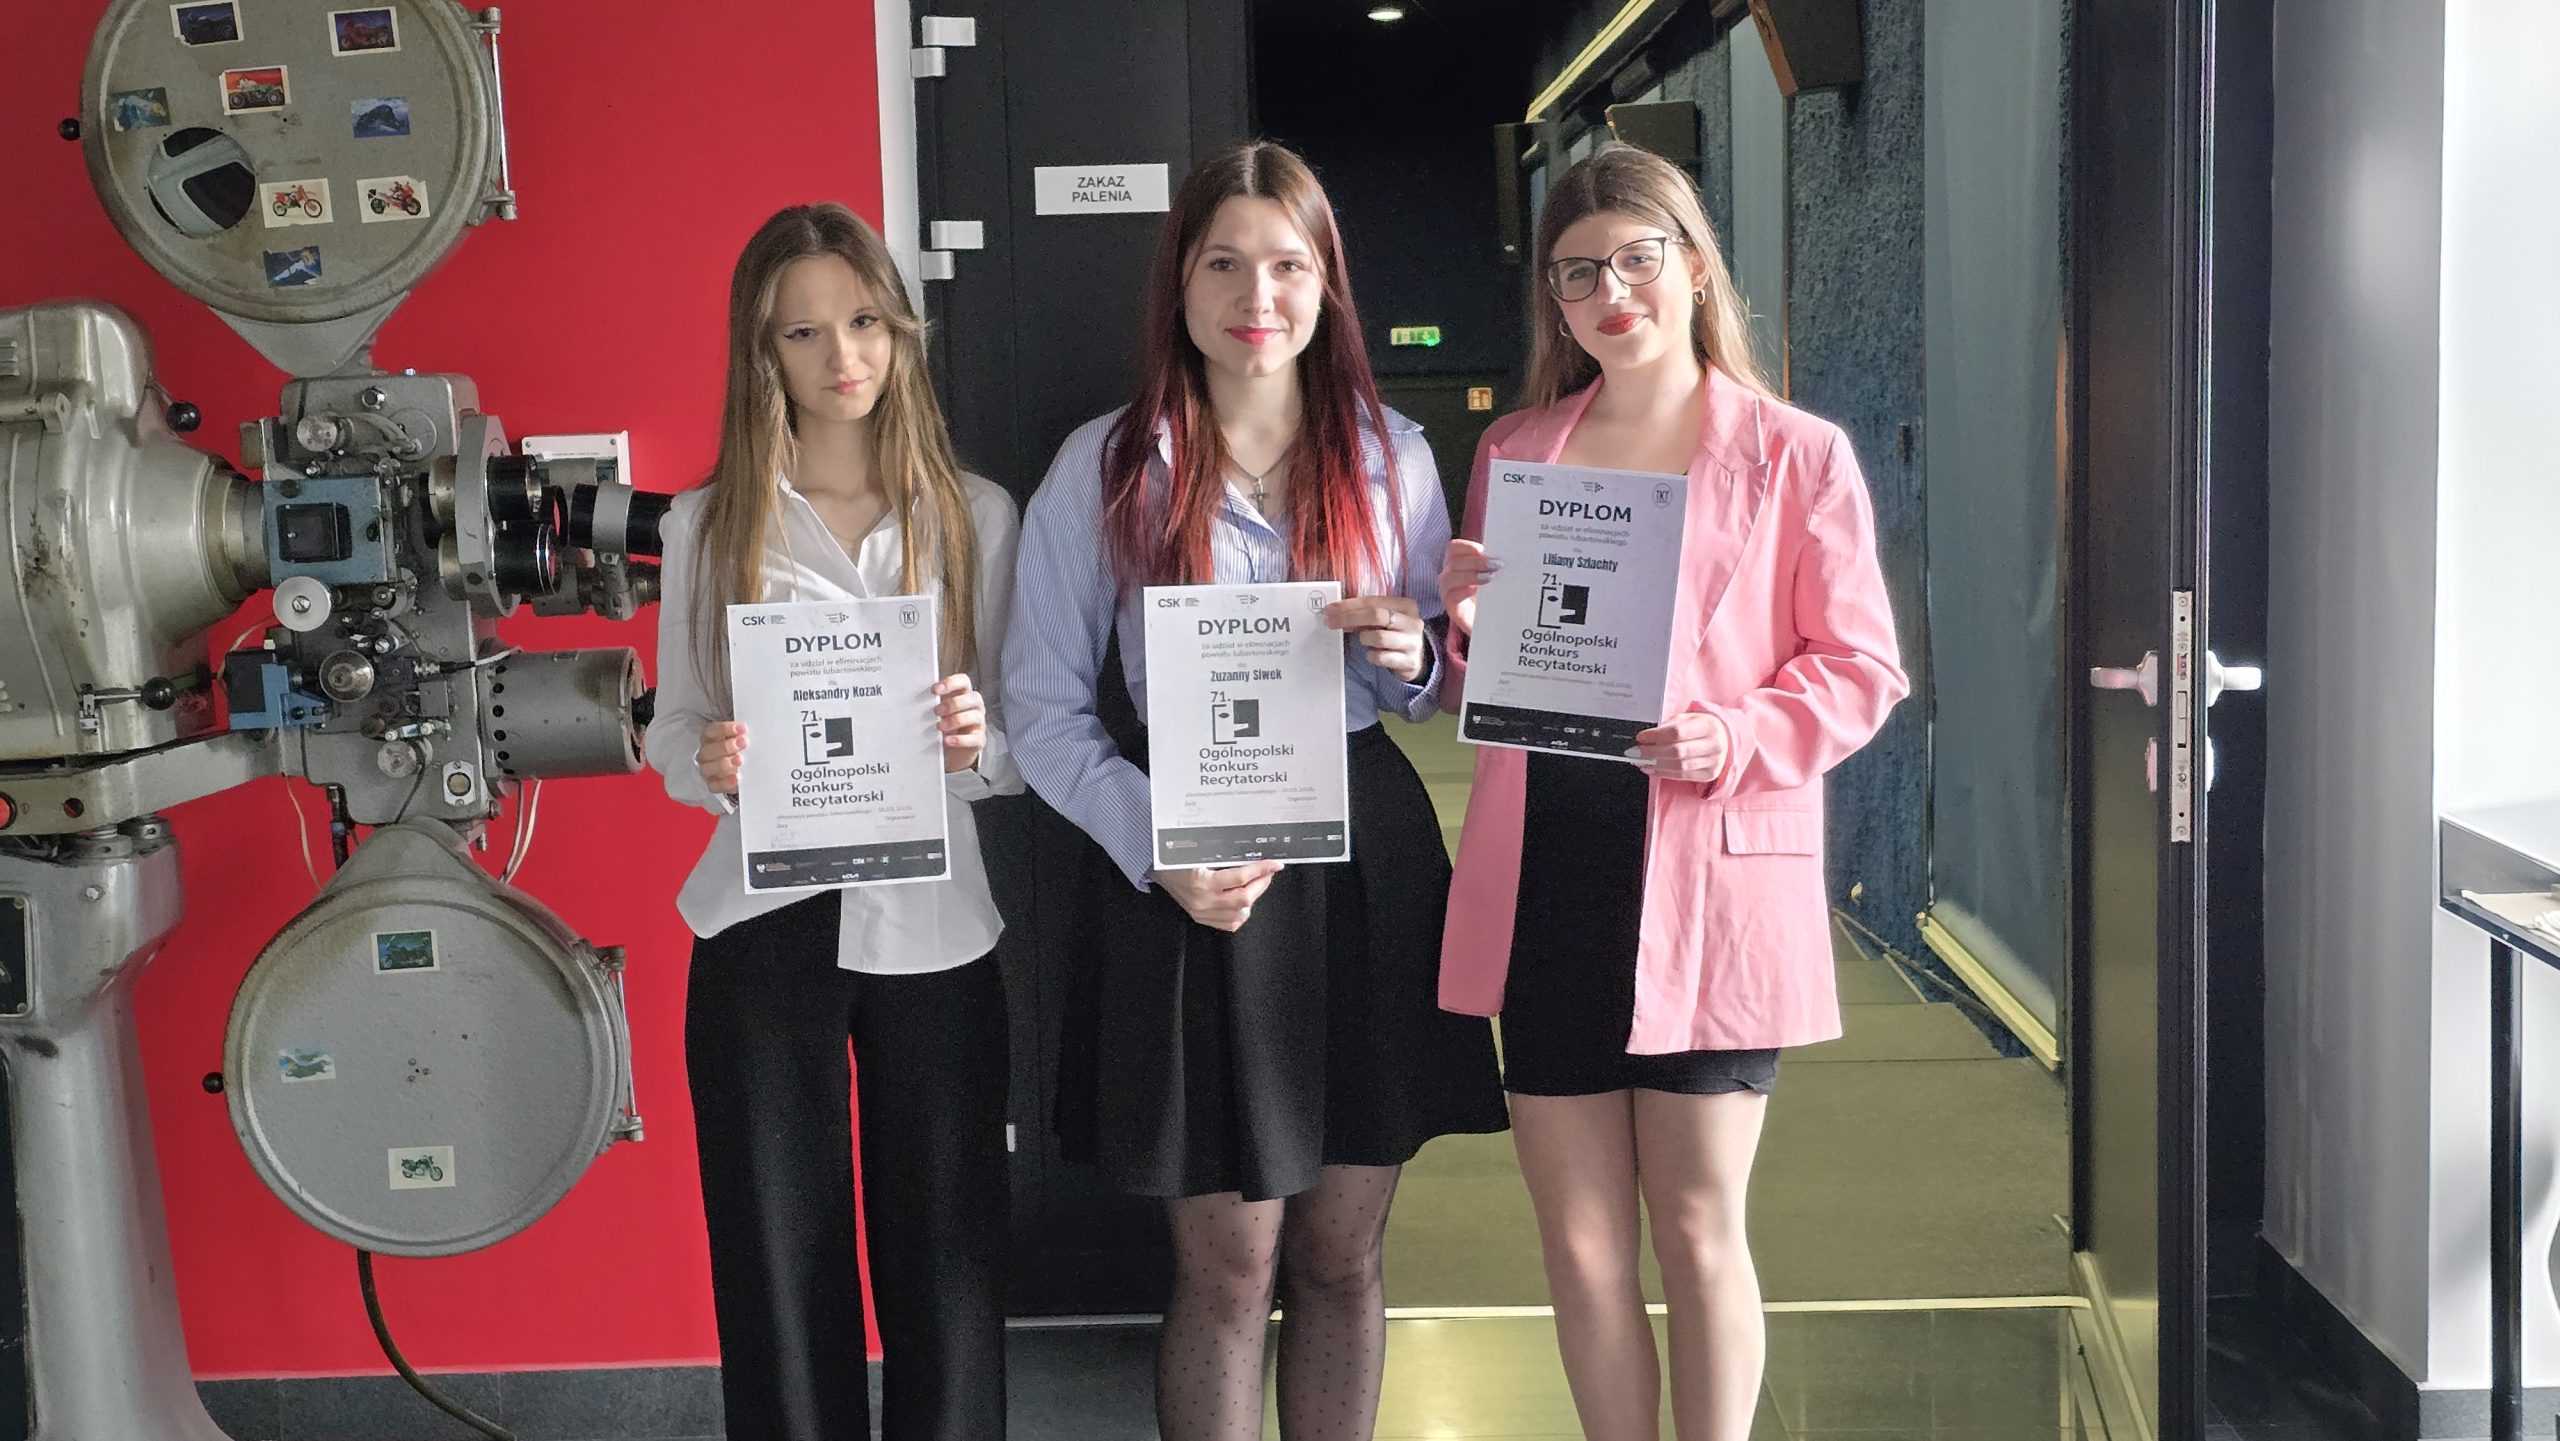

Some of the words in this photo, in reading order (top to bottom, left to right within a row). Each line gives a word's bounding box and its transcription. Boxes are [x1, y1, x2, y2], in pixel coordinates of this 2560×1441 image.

[1077, 176, 1126, 188] ZAKAZ
[1072, 190, 1132, 202] PALENIA
[1503, 472, 1526, 484] CSK
[1539, 499, 1632, 523] DYPLOM
[1543, 552, 1575, 568] Liliany
[1577, 555, 1618, 573] Szlachty
[1542, 572, 1562, 586] 71.
[1158, 597, 1181, 608] CSK
[742, 616, 766, 626] CSK
[1198, 616, 1290, 635] DYPLOM
[785, 632, 882, 654] DYPLOM
[1521, 628, 1618, 649] Ogólnopolski
[1520, 642, 1580, 659] Konkurs
[1518, 655, 1607, 675] Recytatorski
[1211, 670, 1249, 683] Zuzanny
[1253, 668, 1282, 681] Siwek
[793, 687, 850, 702] Aleksandry
[853, 684, 882, 698] Kozak
[1210, 690, 1231, 703] 71.
[800, 710, 823, 722] 71.
[1199, 744, 1294, 761] Ogólnopolski
[790, 762, 890, 782] Ogólnopolski
[1199, 760, 1259, 773] Konkurs
[1200, 771, 1288, 787] Recytatorski
[791, 781, 853, 794] Konkurs
[792, 790, 884, 808] Recytatorski
